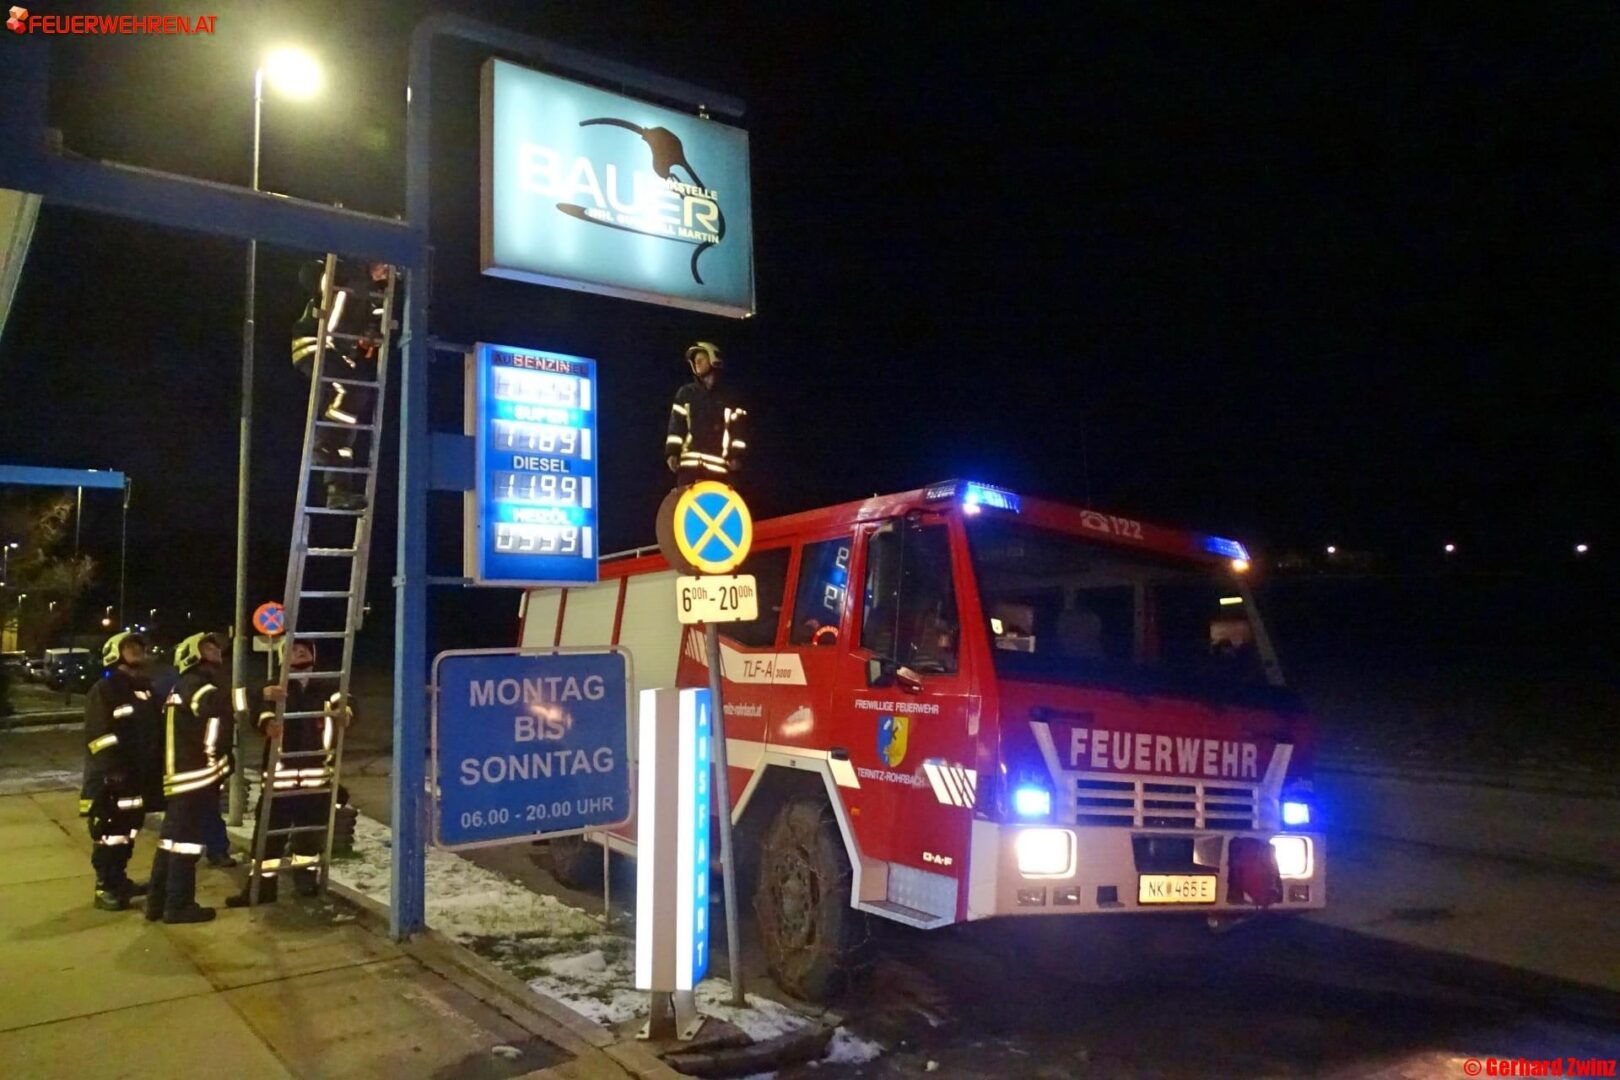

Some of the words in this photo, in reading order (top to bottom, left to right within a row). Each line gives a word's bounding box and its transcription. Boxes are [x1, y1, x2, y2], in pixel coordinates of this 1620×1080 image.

[518, 141, 718, 233] BAUER
[678, 227, 719, 244] MARTIN
[513, 354, 570, 373] BENZIN
[513, 456, 570, 473] DIESEL
[1110, 515, 1144, 540] 122
[743, 660, 773, 678] TLF-A
[469, 675, 605, 707] MONTAG
[855, 699, 894, 712] FREIWILLIGE
[895, 701, 940, 715] FEUERWEHR
[514, 714, 566, 743] BIS
[1070, 727, 1258, 779] FEUERWEHR
[459, 746, 614, 786] SONNTAG
[461, 808, 509, 829] 06.00
[526, 801, 571, 821] 20.00
[577, 797, 614, 815] UHR
[1148, 881, 1165, 897] NK
